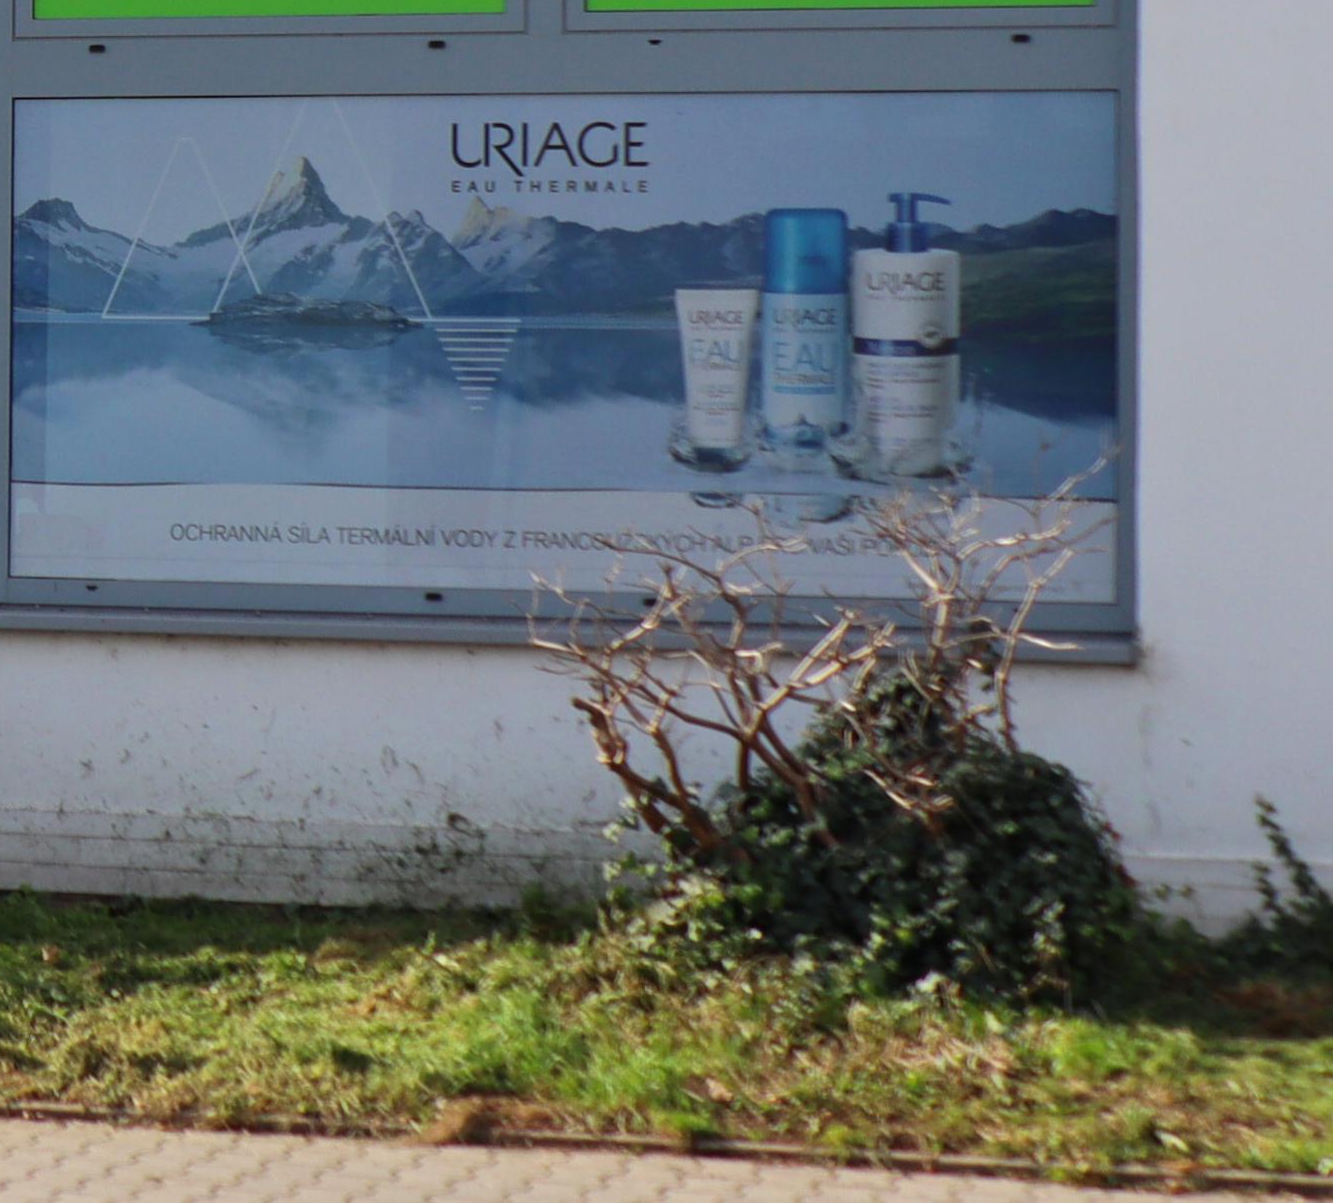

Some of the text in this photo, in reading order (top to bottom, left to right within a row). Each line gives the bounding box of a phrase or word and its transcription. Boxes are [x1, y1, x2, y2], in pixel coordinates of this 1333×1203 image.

[451, 122, 650, 177] URIAGE
[451, 180, 649, 193] EAU THERMALE
[170, 521, 282, 543] OCHRANNÁ
[288, 522, 331, 544] SÍLA
[337, 525, 435, 546] TERMÁLNÍ
[440, 529, 495, 548] VODY
[503, 531, 516, 548] Z
